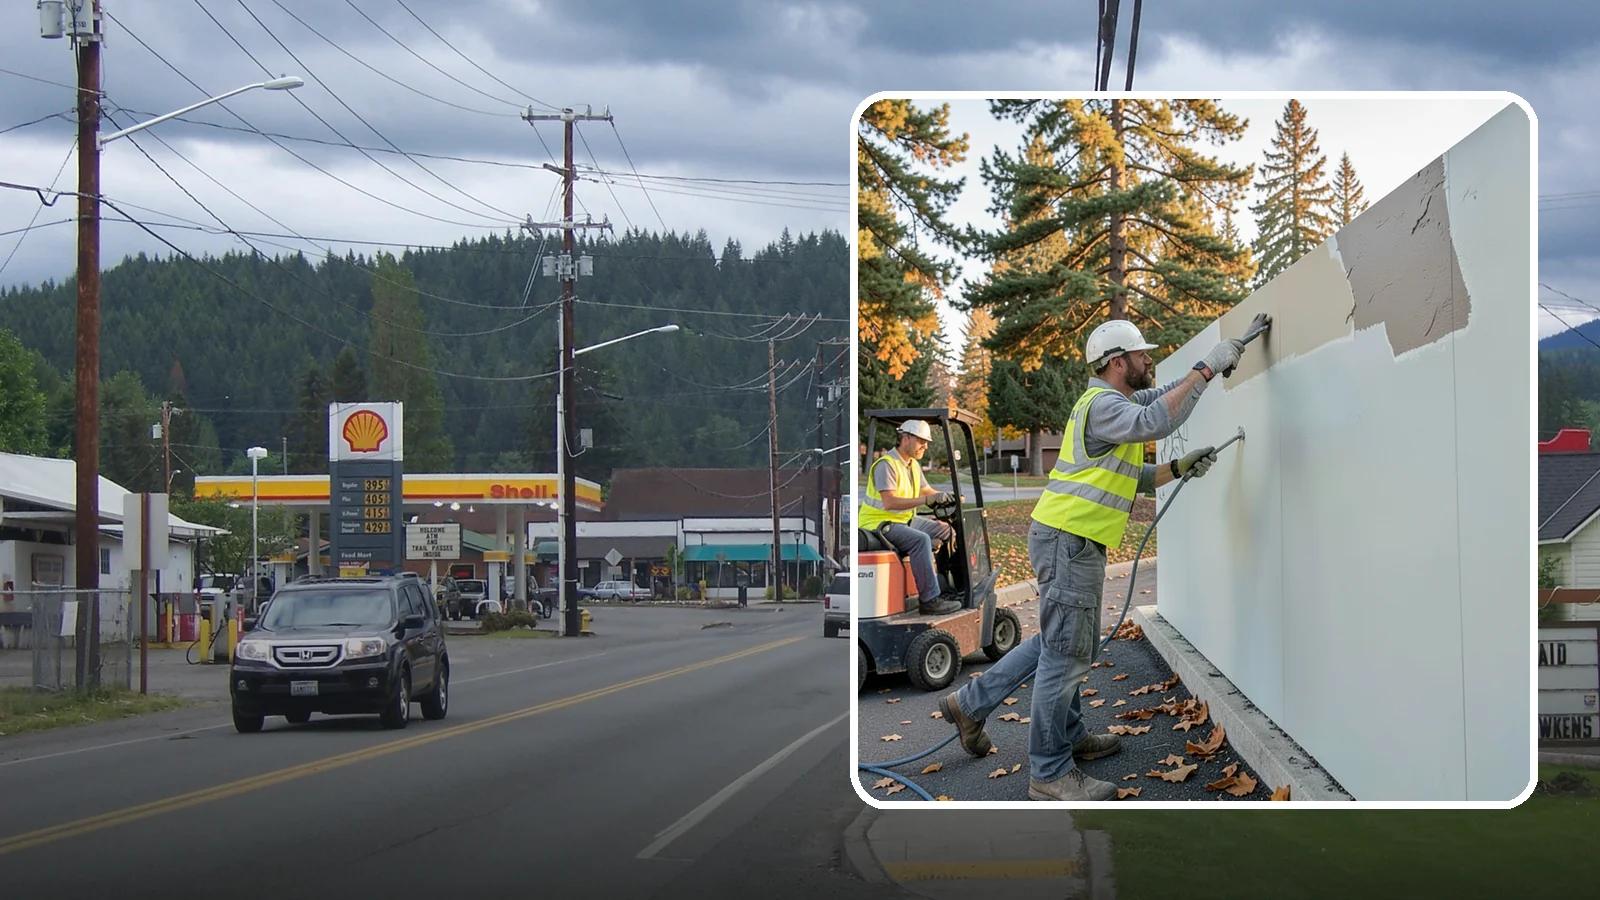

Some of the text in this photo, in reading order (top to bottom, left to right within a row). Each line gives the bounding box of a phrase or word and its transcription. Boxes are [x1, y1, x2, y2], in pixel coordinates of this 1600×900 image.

[366, 480, 384, 490] 395
[490, 484, 547, 499] Shell
[366, 494, 384, 504] 405
[365, 508, 384, 518] 415
[366, 522, 384, 532] 429
